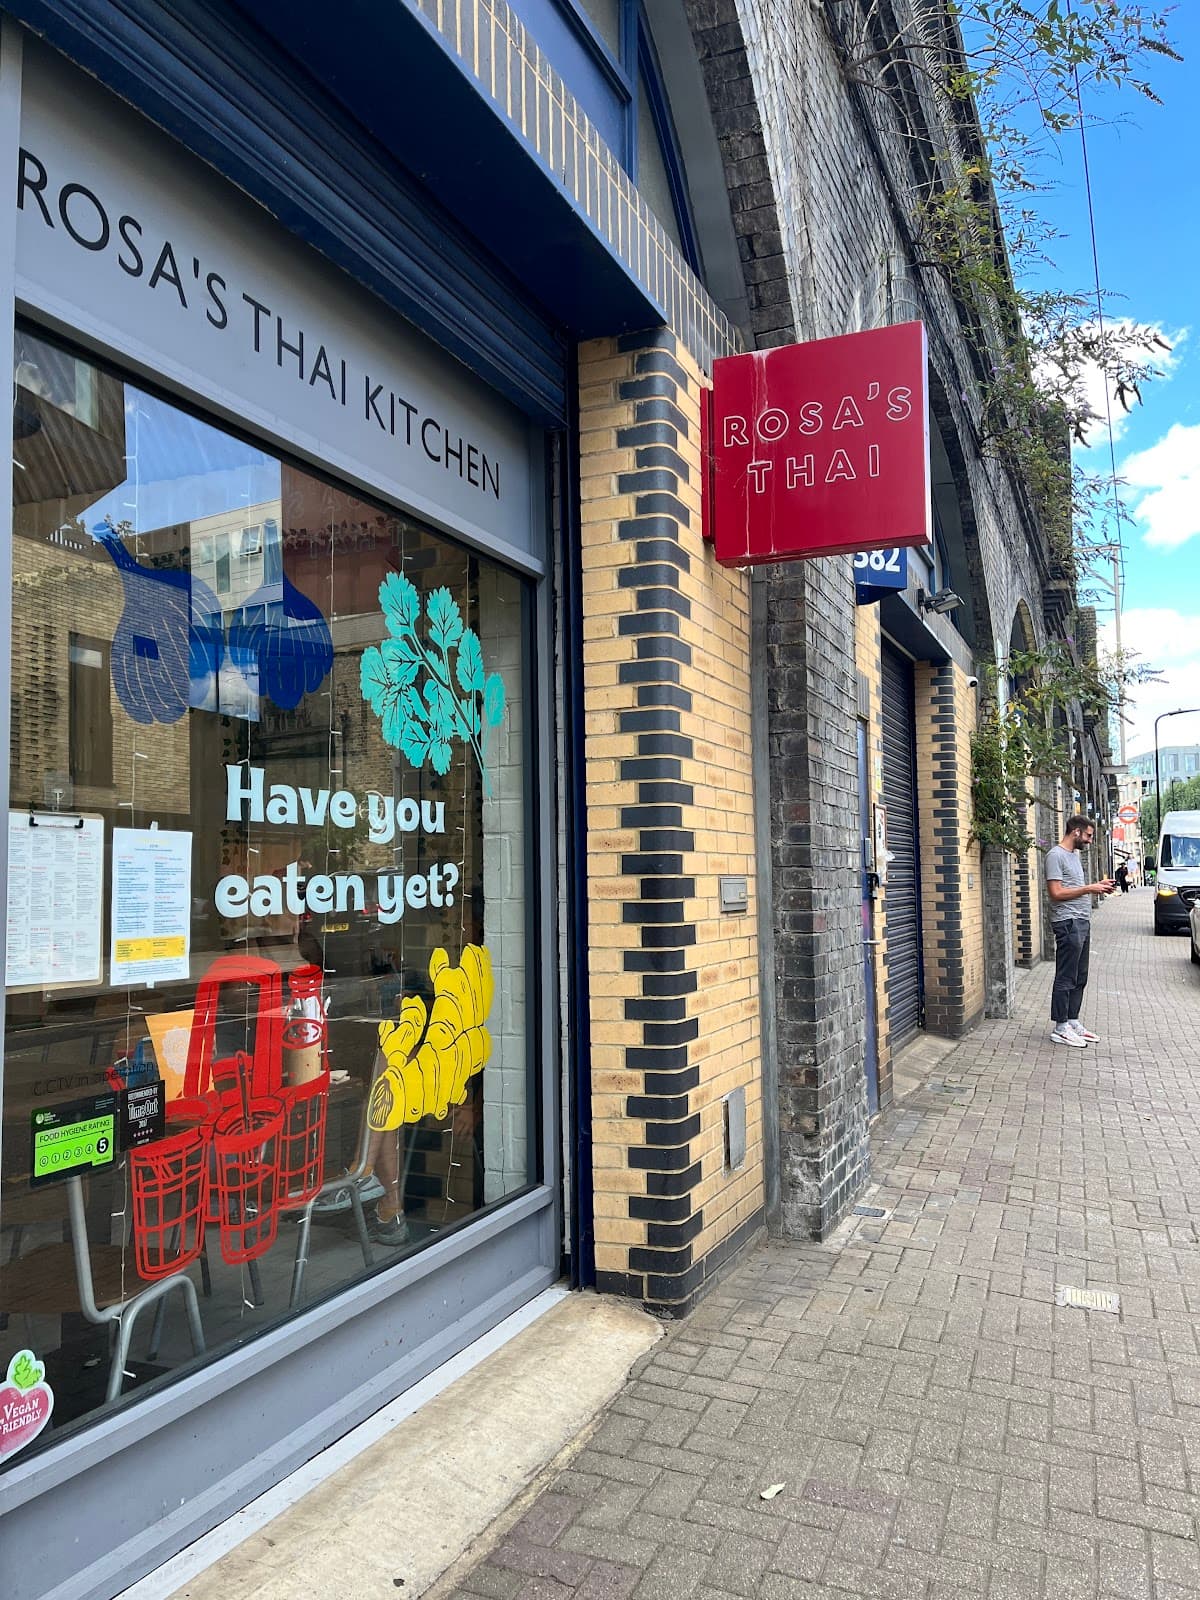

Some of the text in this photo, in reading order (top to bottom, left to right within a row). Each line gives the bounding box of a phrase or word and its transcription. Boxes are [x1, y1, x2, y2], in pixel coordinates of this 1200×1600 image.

[17, 147, 502, 500] ROSA'S THAI KITCHEN
[723, 381, 912, 447] ROSA'S
[747, 444, 880, 493] THAI
[226, 763, 446, 844] Have you
[214, 860, 365, 918] eaten
[376, 861, 460, 924] yet?
[39, 1118, 110, 1143] FOOD HYGIENE RATING
[98, 1138, 107, 1152] 5
[3, 1398, 39, 1421] VEGAN
